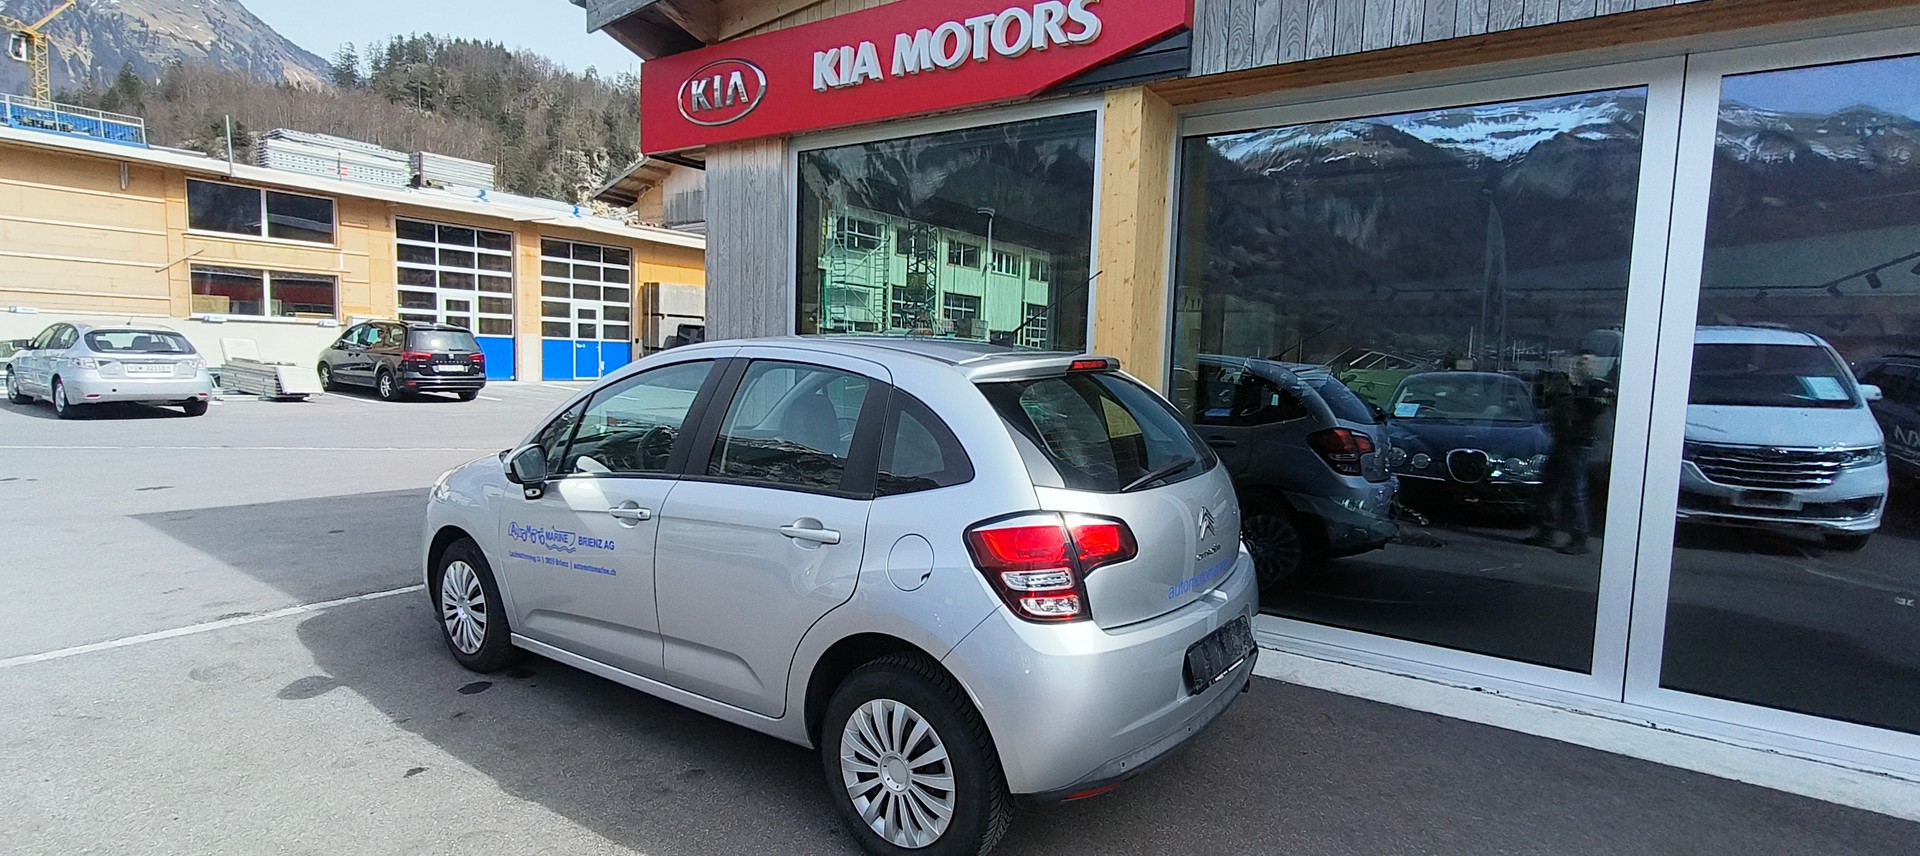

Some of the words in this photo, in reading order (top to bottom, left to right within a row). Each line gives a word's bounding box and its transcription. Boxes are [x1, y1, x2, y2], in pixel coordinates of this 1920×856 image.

[812, 41, 884, 92] KIA
[891, 0, 1102, 77] MOTORS
[690, 71, 749, 112] KIA
[545, 531, 569, 543] MARINE
[578, 536, 603, 549] BRIENZ
[604, 540, 615, 550] AG
